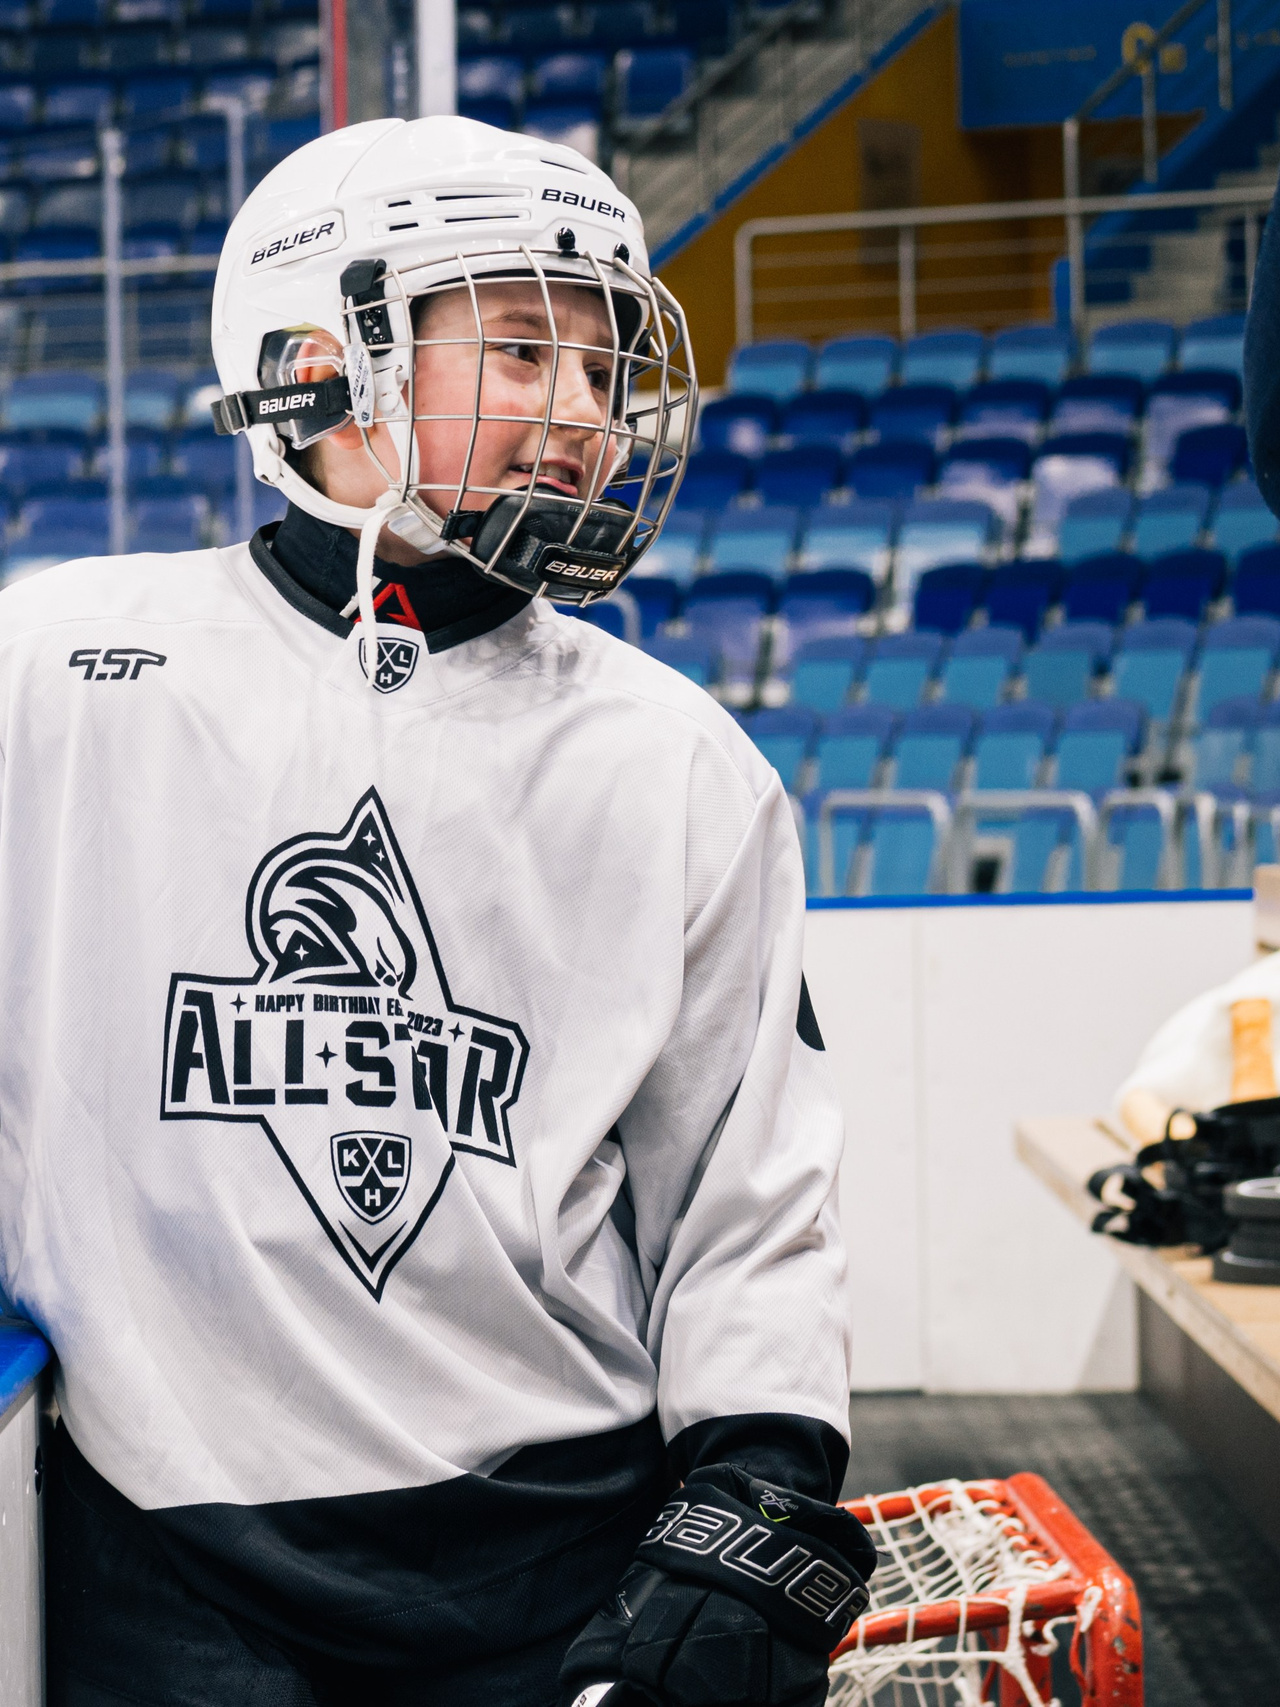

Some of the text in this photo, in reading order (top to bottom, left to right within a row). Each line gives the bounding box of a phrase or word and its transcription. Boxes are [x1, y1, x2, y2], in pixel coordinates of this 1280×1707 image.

[541, 188, 626, 223] BAUER
[250, 221, 336, 266] BAUER
[258, 392, 316, 415] BAUER
[545, 560, 619, 582] BAUER
[255, 994, 304, 1012] HAPPY
[313, 994, 380, 1015] BIRTHDAY
[407, 1011, 443, 1037] 2023
